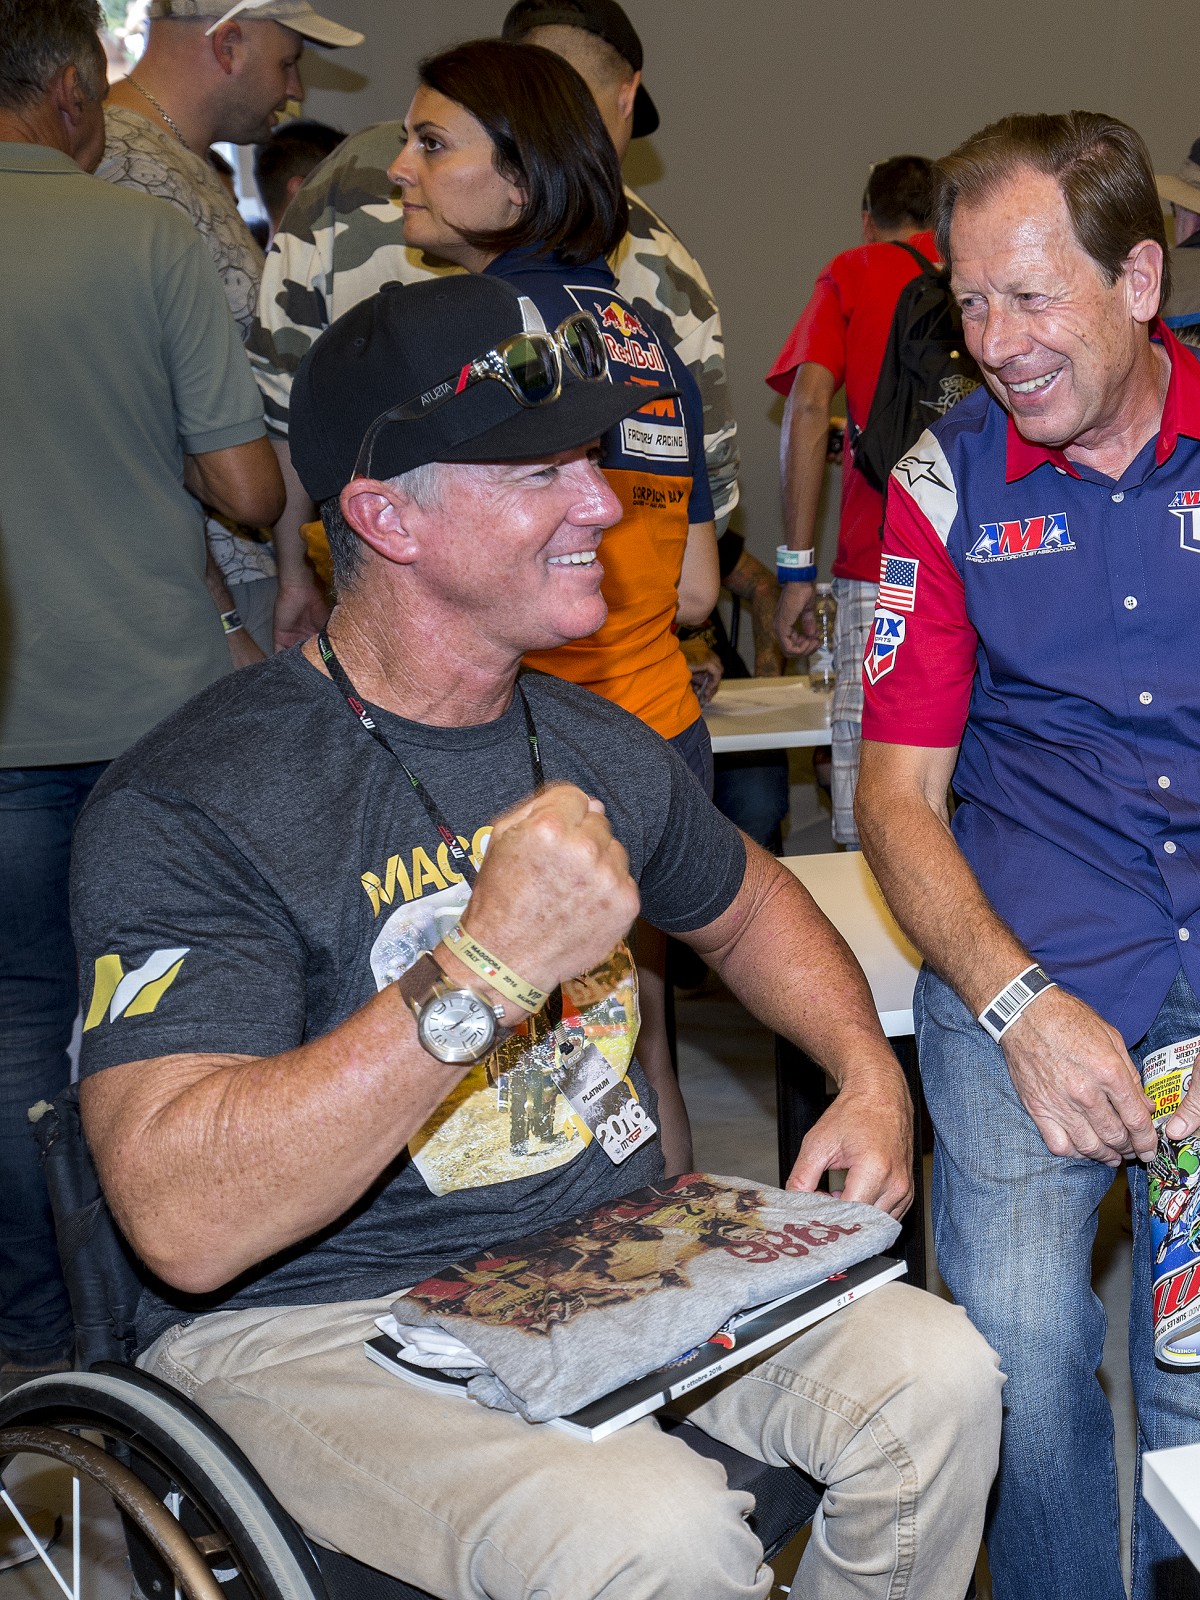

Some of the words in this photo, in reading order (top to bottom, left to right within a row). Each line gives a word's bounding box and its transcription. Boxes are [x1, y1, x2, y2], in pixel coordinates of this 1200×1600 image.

[602, 333, 635, 367] Red
[631, 340, 665, 372] Bull
[628, 428, 652, 445] FACTORY
[656, 431, 683, 448] RACING
[668, 490, 685, 504] BAY
[966, 512, 1076, 559] AMA
[1037, 546, 1077, 556] ASSOCIATION
[464, 949, 480, 963] ITALY
[470, 945, 501, 972] MAGGIORA
[527, 989, 542, 1000] VIP
[1174, 1042, 1197, 1053] COSTER
[1154, 1059, 1166, 1067] KEN
[581, 1078, 610, 1103] PLATINUM
[1157, 1085, 1180, 1098] QUELLE
[1160, 1093, 1180, 1107] 450
[595, 1098, 645, 1147] 2016
[724, 1220, 861, 1263] 1986
[1167, 1317, 1176, 1330] LES
[1175, 1312, 1187, 1323] SUR
[686, 1374, 708, 1389] ottobre
[709, 1365, 722, 1377] 2016
